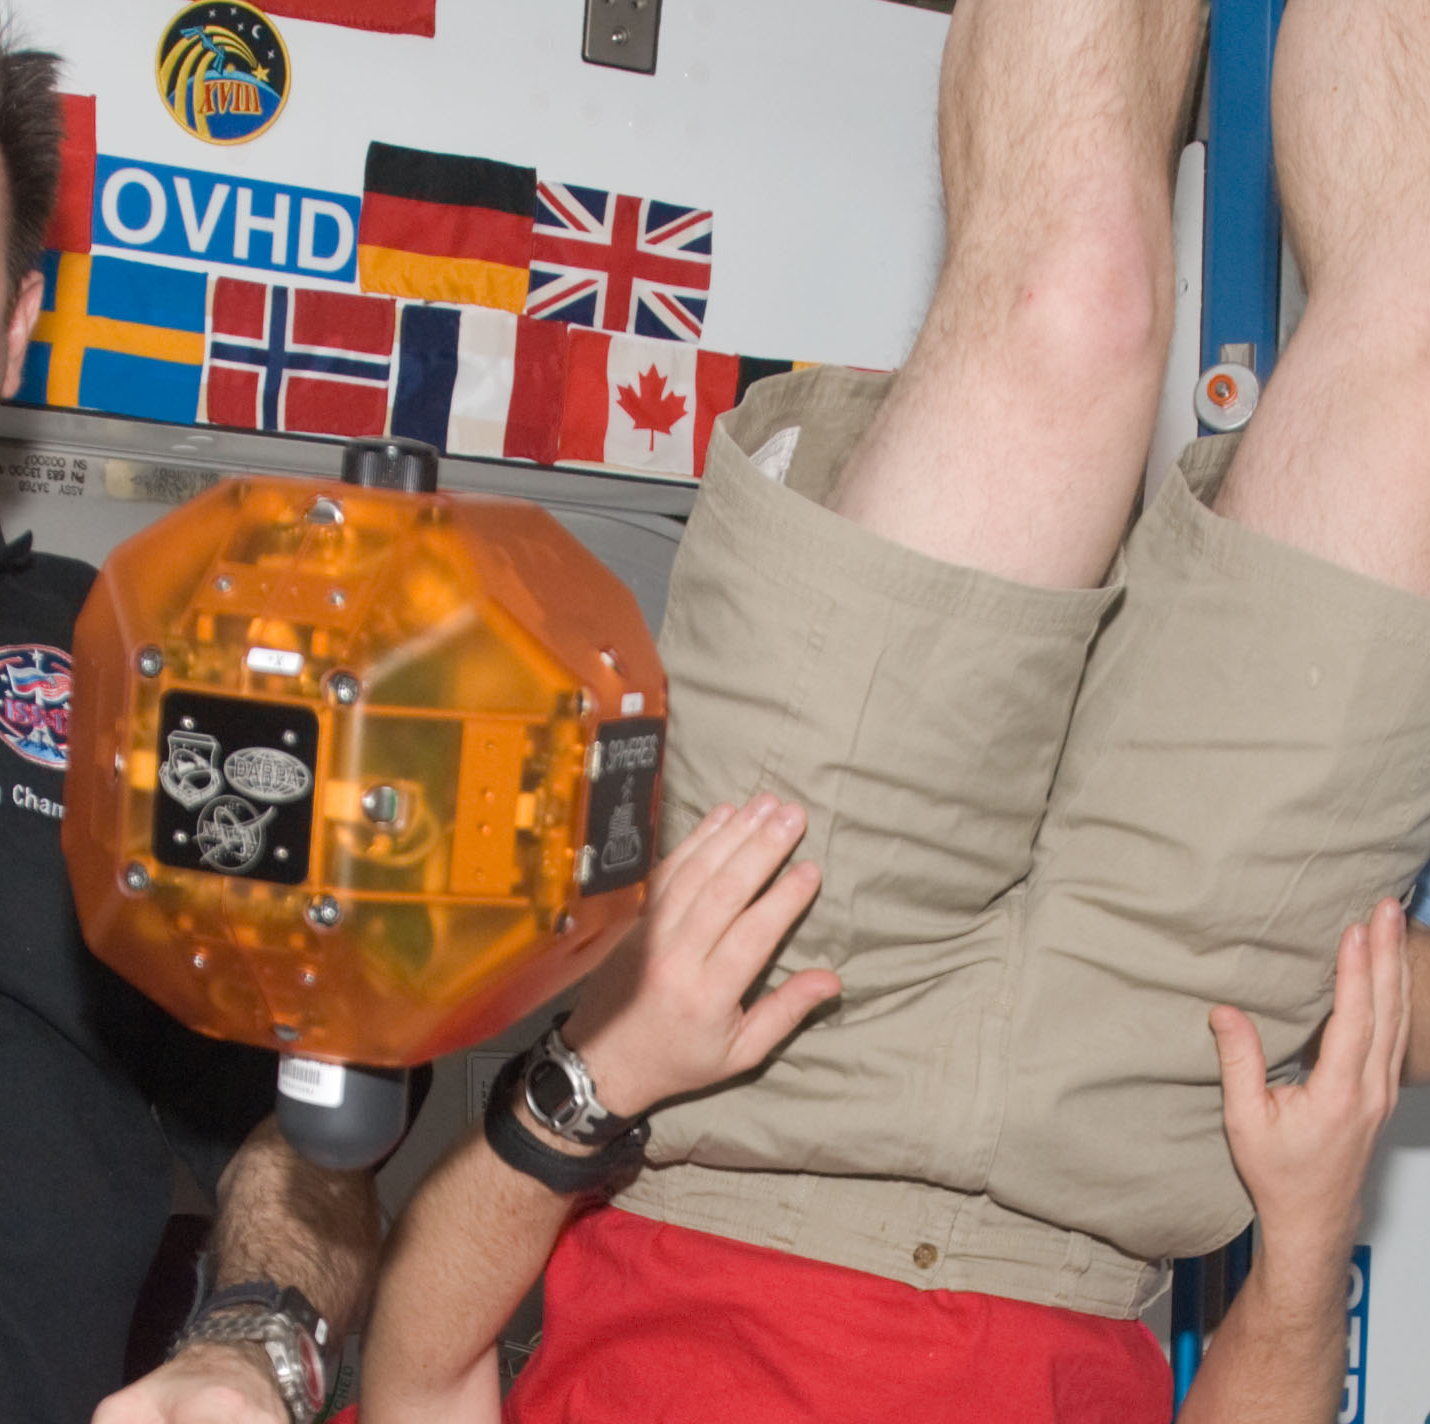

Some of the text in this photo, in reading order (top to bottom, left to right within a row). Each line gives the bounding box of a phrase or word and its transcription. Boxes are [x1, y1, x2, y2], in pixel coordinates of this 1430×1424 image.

[198, 80, 262, 115] XVIII
[101, 167, 356, 273] OVHD
[59, 483, 83, 496] ASSY
[234, 755, 301, 790] DARPA
